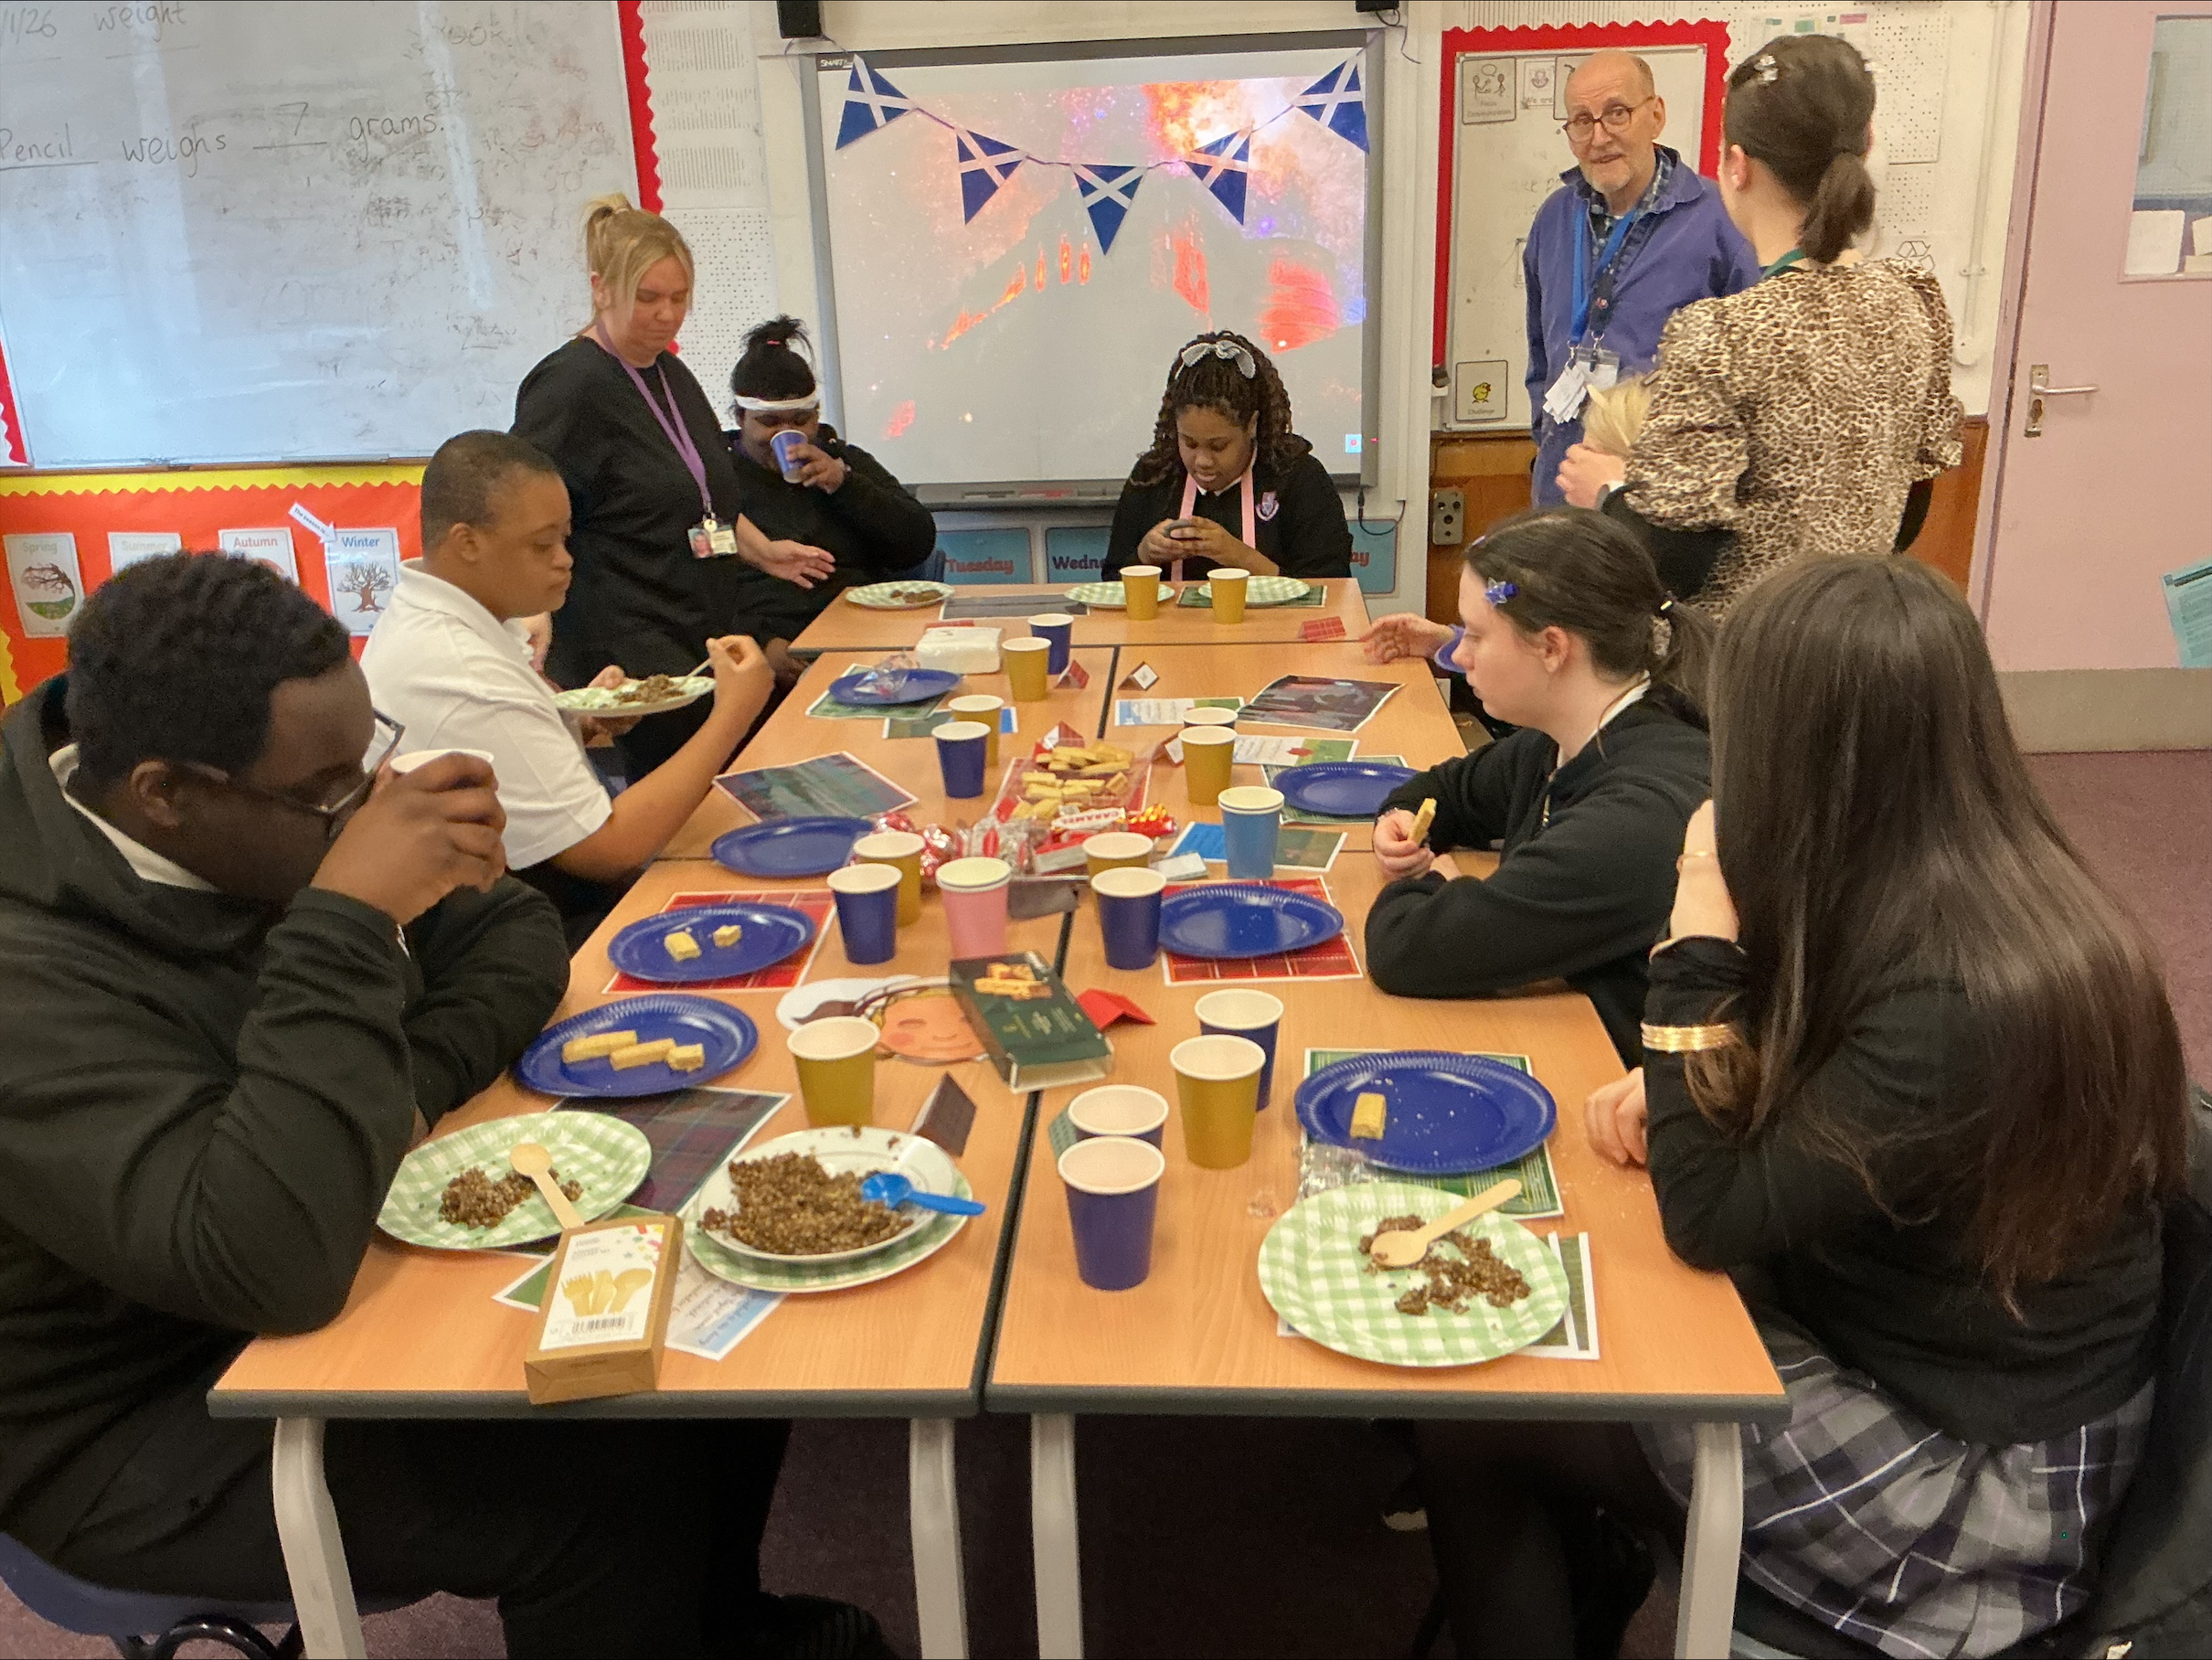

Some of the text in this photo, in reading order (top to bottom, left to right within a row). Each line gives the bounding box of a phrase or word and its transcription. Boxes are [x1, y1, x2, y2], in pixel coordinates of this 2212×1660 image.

[94, 4, 186, 42] weight
[0, 122, 74, 163] Pencil
[122, 122, 227, 179] weighs
[280, 101, 309, 137] 7
[294, 506, 303, 517] The
[303, 514, 321, 530] season
[22, 540, 58, 556] Spring
[121, 539, 168, 552] Summer
[233, 537, 279, 548] Autumn
[341, 536, 380, 548] Winter
[946, 557, 1015, 575] Tuesday
